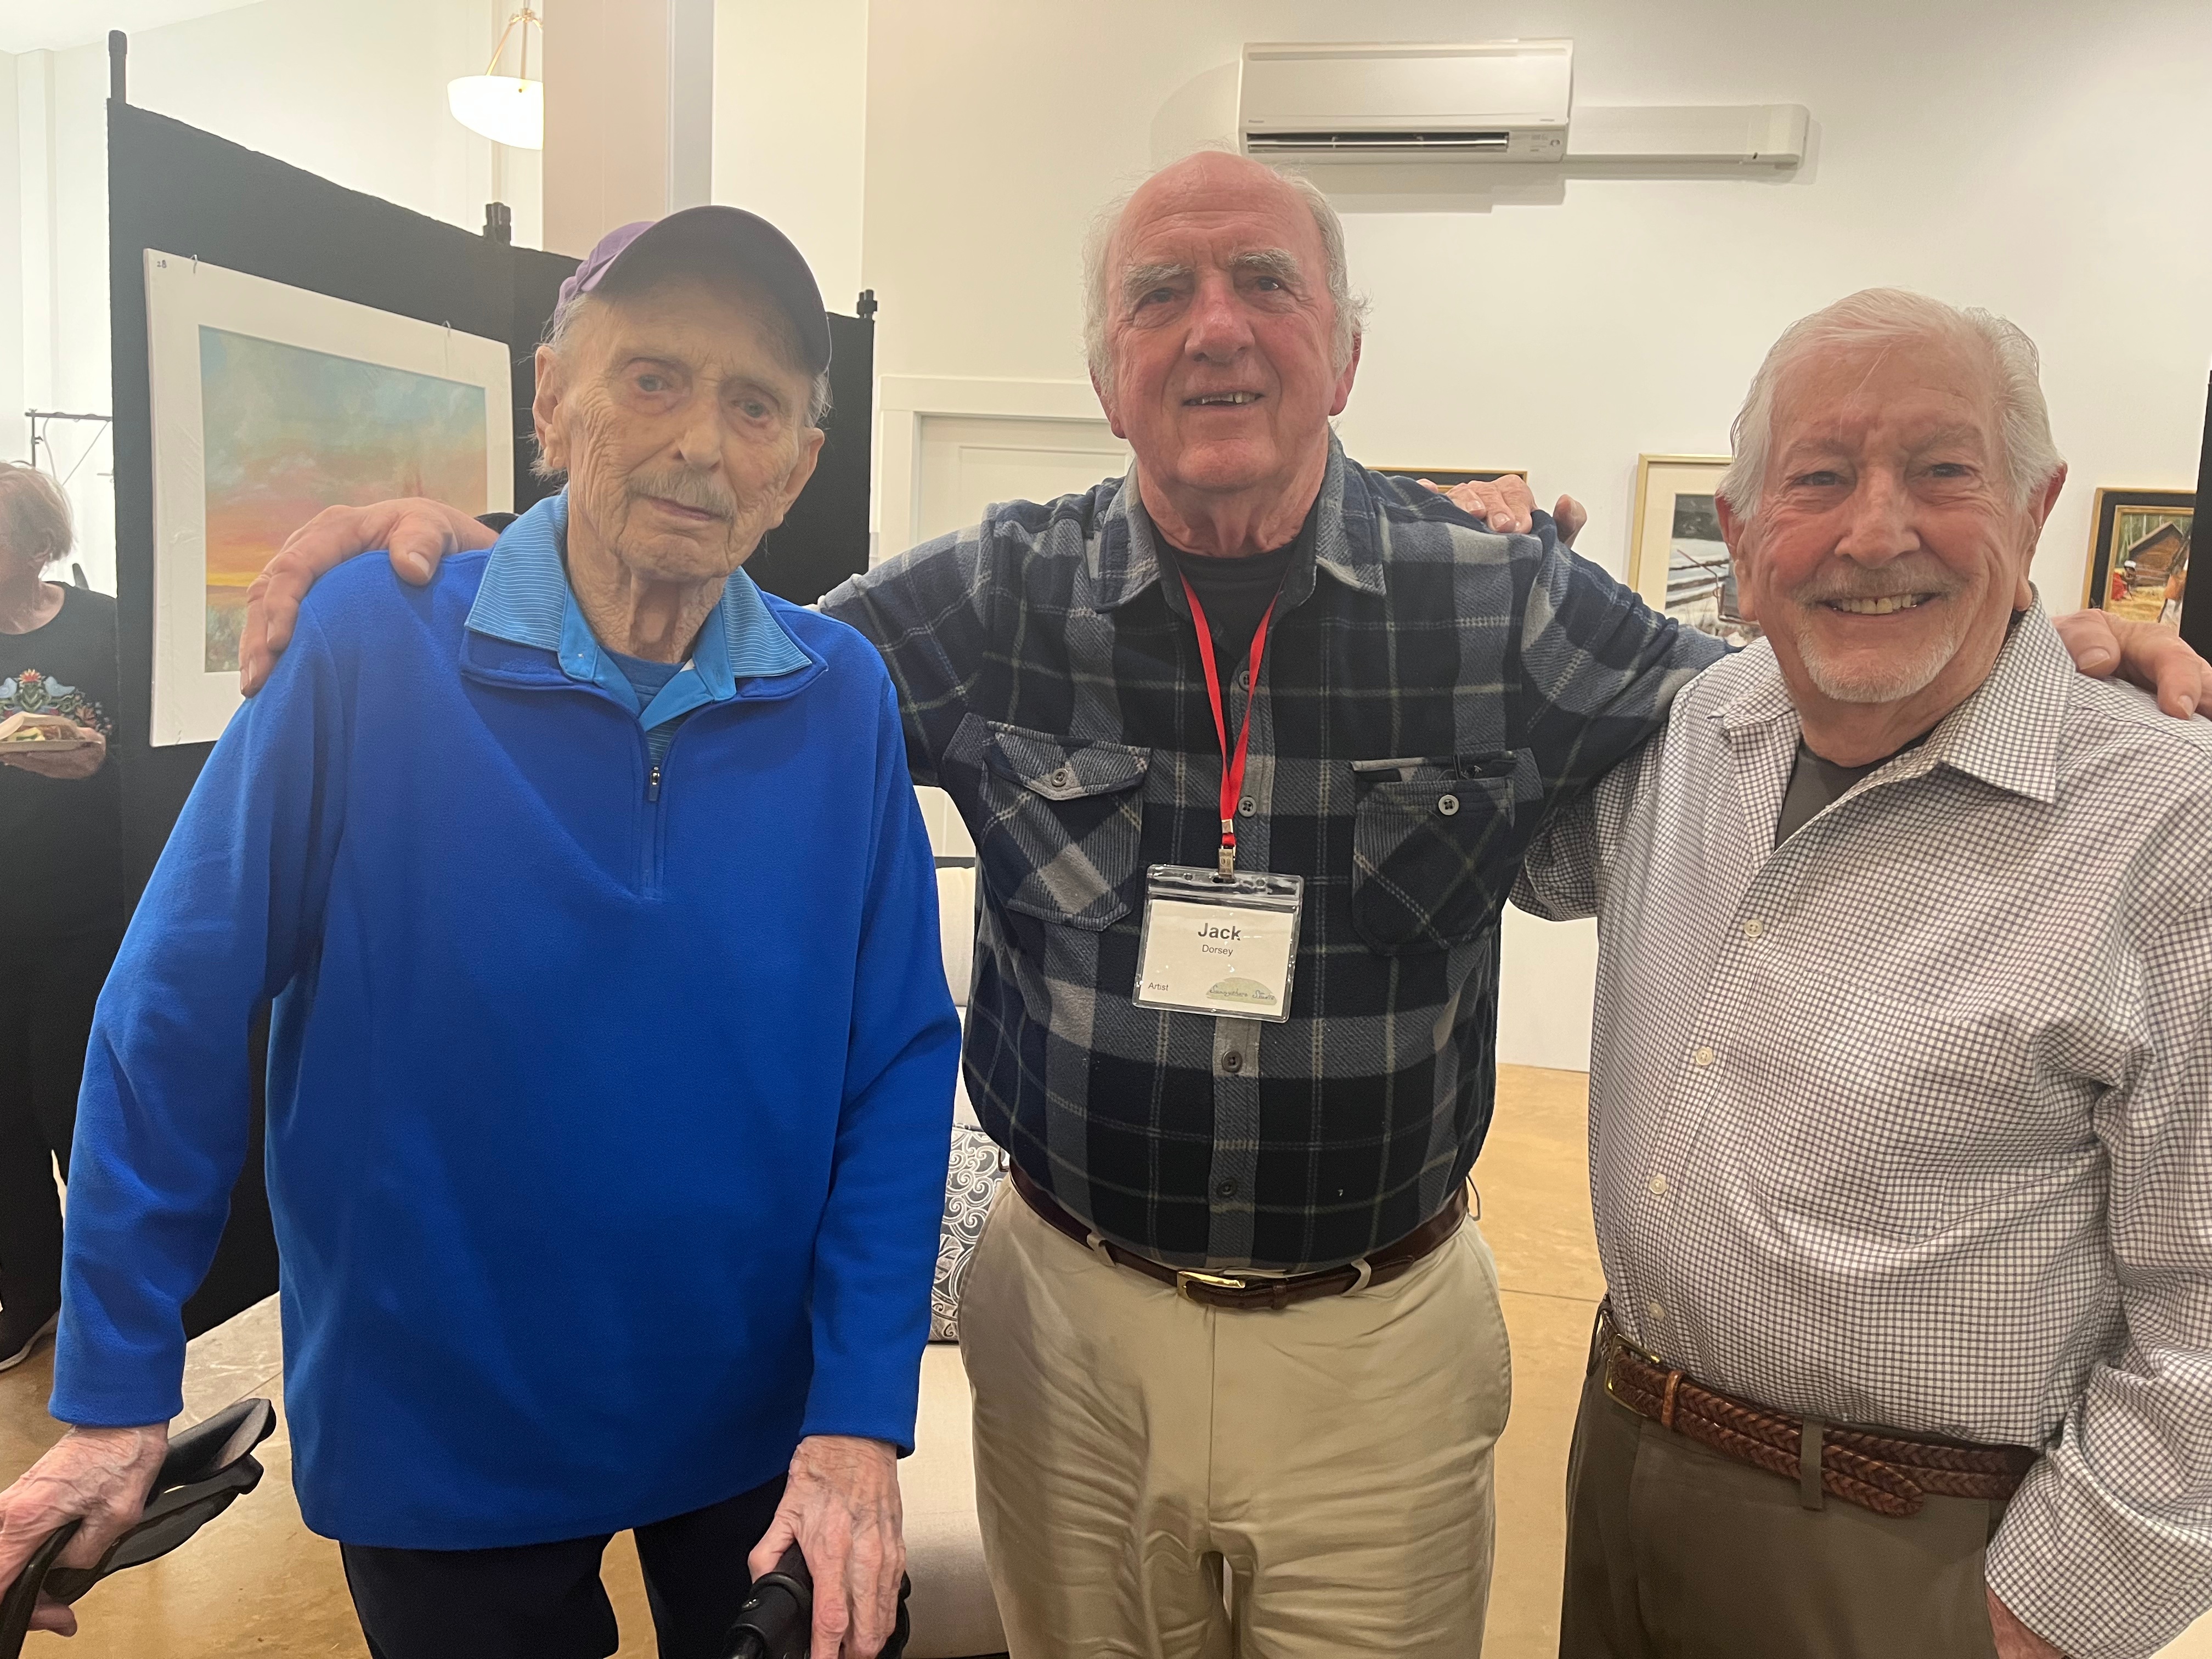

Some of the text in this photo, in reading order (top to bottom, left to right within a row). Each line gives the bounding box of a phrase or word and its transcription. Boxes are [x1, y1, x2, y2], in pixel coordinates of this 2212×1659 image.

[1198, 923, 1242, 941] Jack
[1202, 944, 1233, 957] Dorsey
[1148, 982, 1169, 991] Artist
